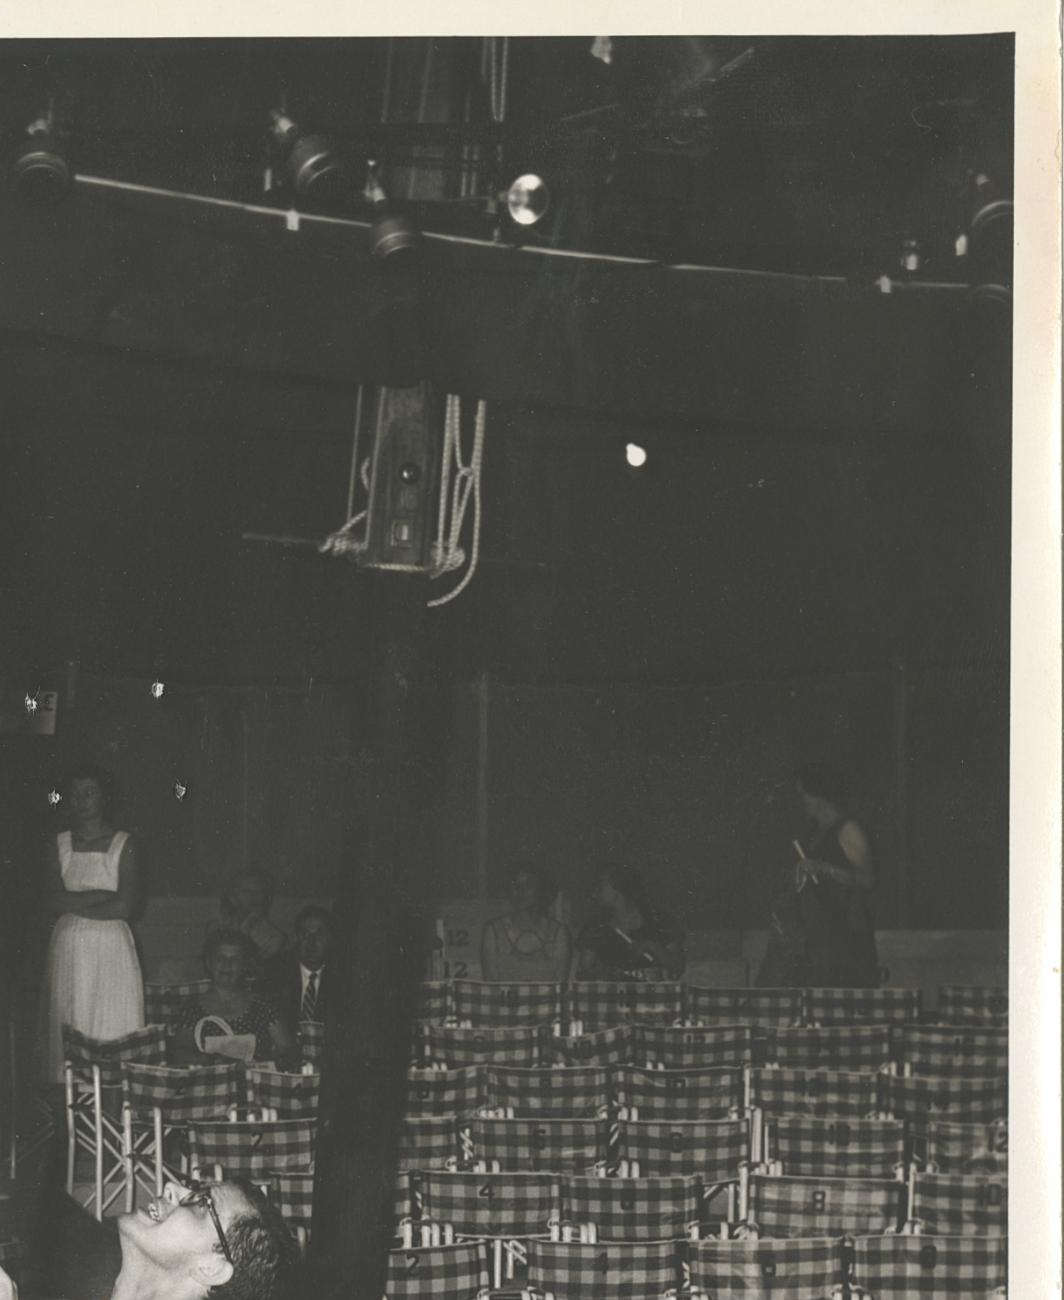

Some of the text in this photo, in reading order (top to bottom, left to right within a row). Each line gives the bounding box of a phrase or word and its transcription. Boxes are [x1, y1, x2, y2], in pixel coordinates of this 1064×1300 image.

[444, 961, 468, 978] 12
[479, 1184, 495, 1200] 4
[812, 1190, 826, 1212] 8
[406, 1254, 421, 1276] 2
[593, 1252, 608, 1275] 4
